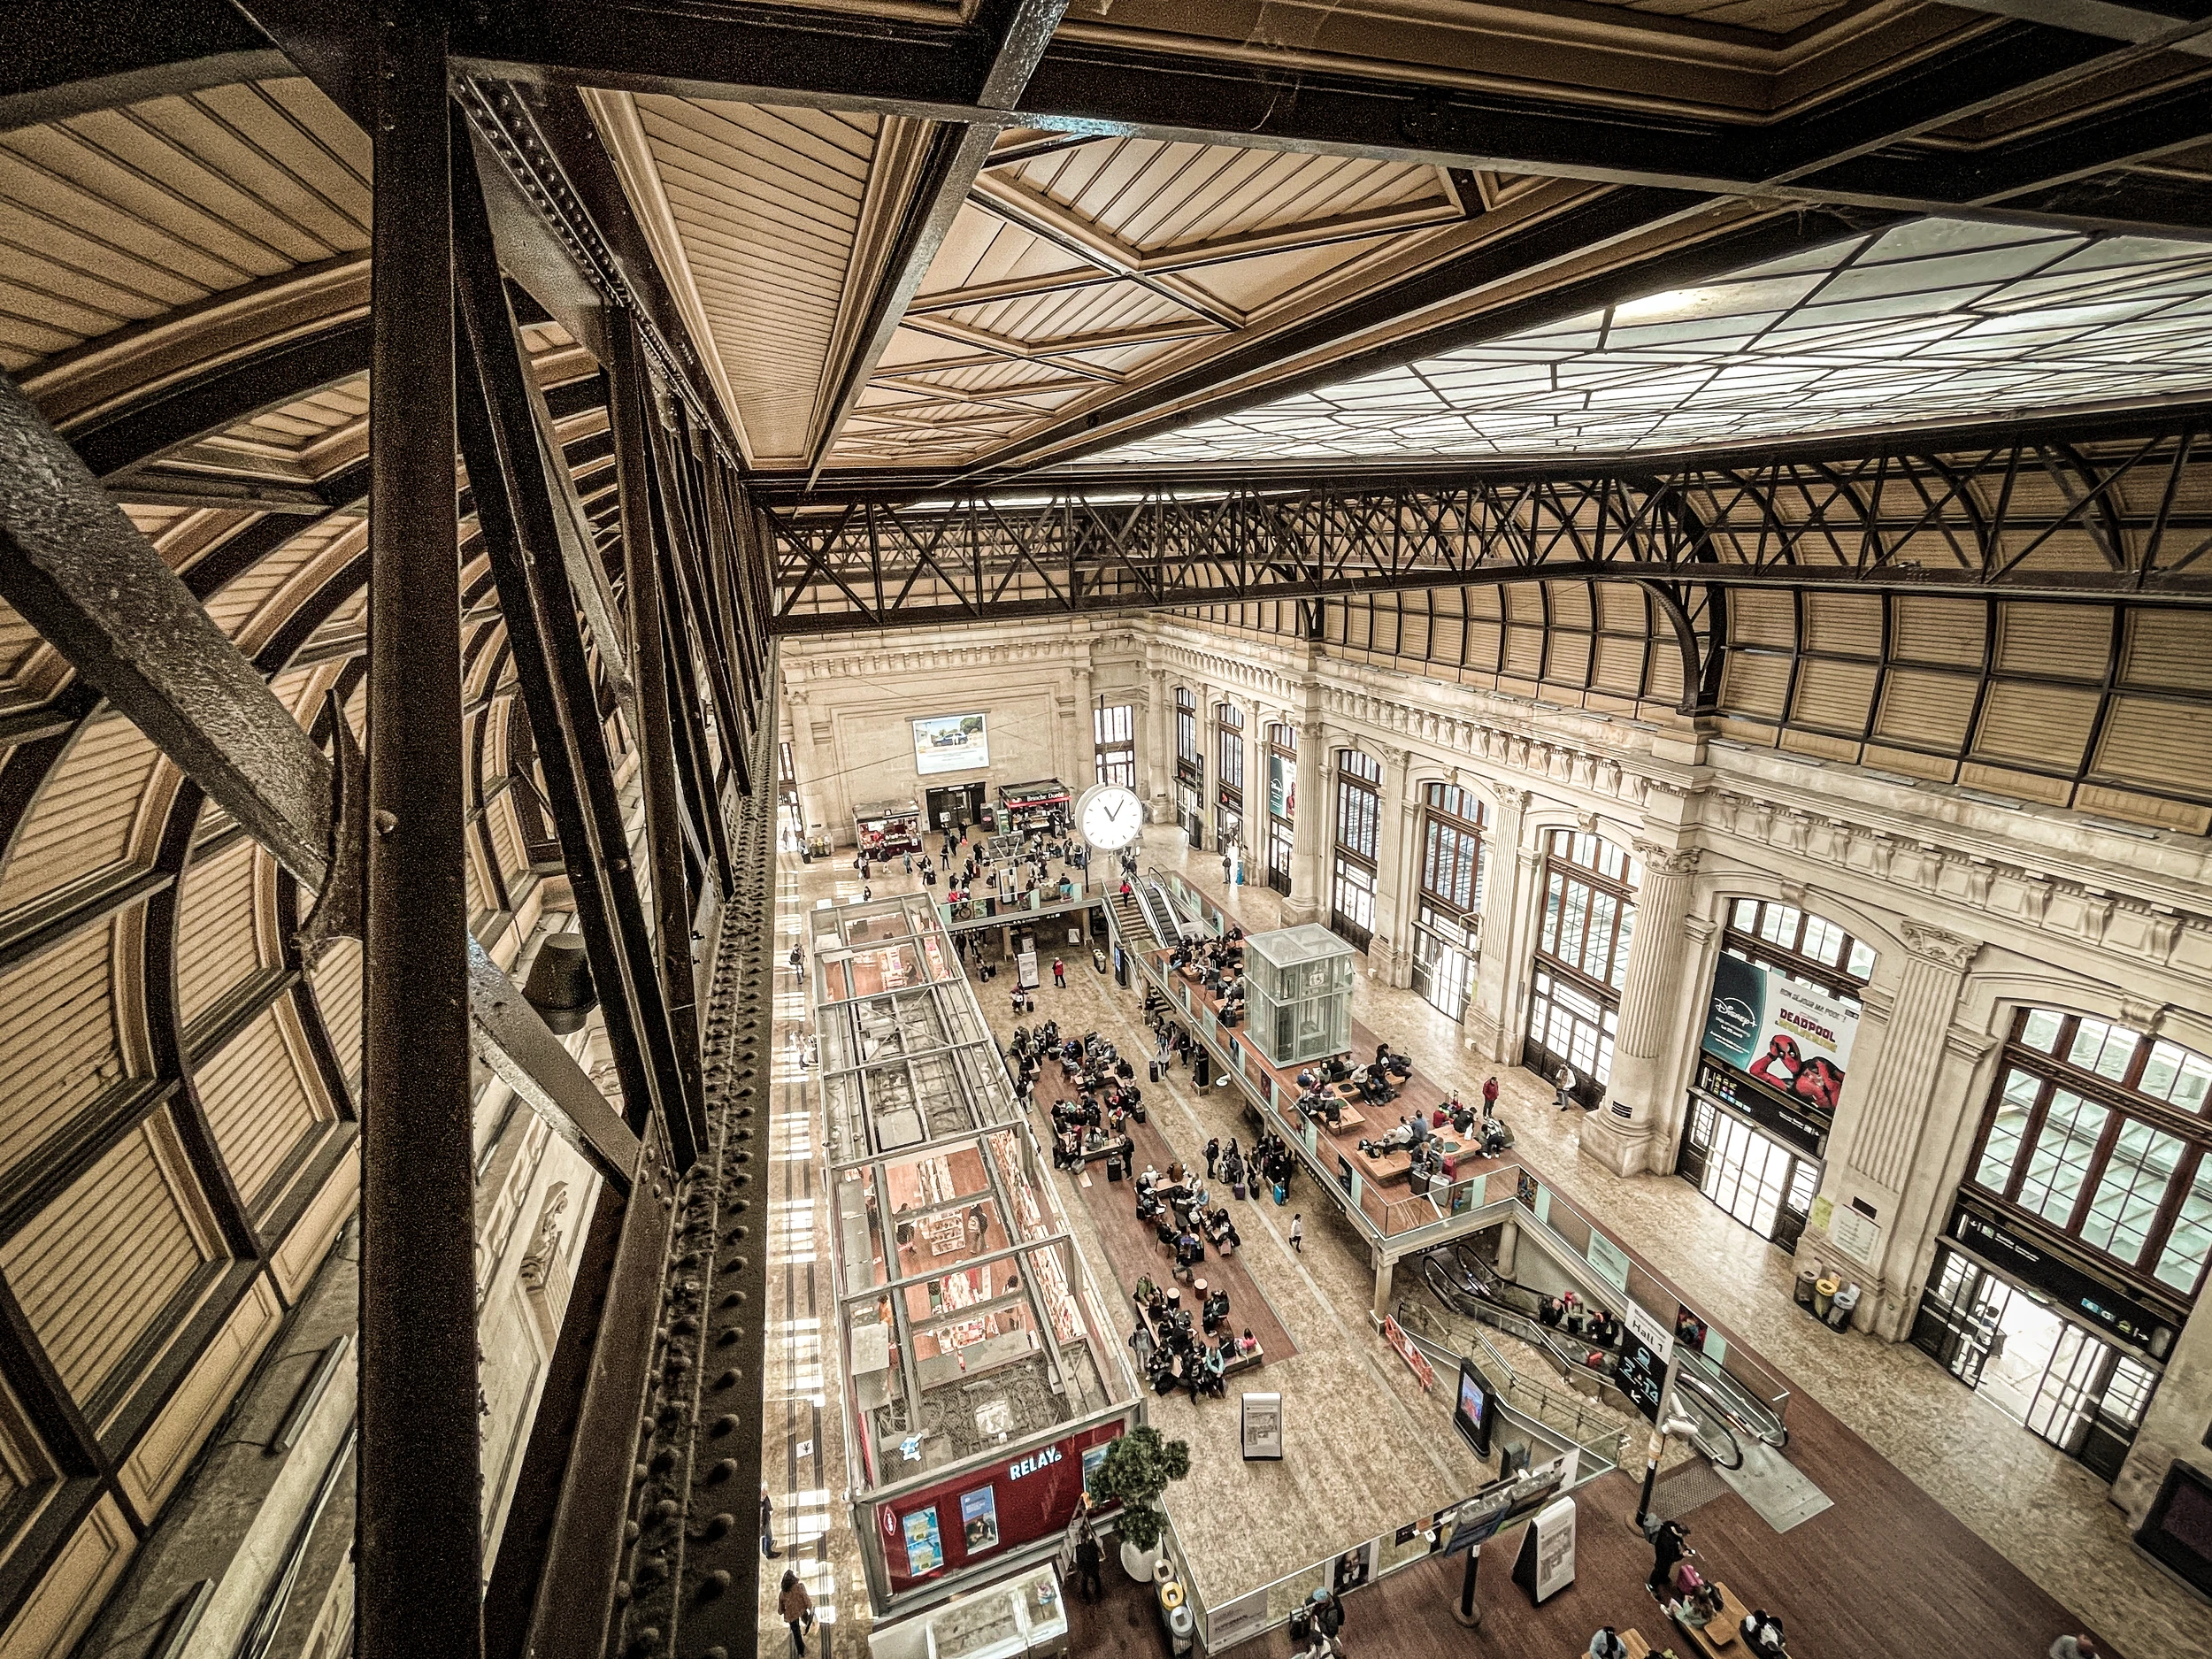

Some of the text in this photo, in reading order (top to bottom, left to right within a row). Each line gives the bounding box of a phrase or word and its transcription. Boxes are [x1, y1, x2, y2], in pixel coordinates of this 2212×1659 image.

[1780, 1008, 1836, 1043] DEADPOOL
[1632, 1319, 1663, 1353] Hall 1
[1010, 1445, 1056, 1482] RELAY
